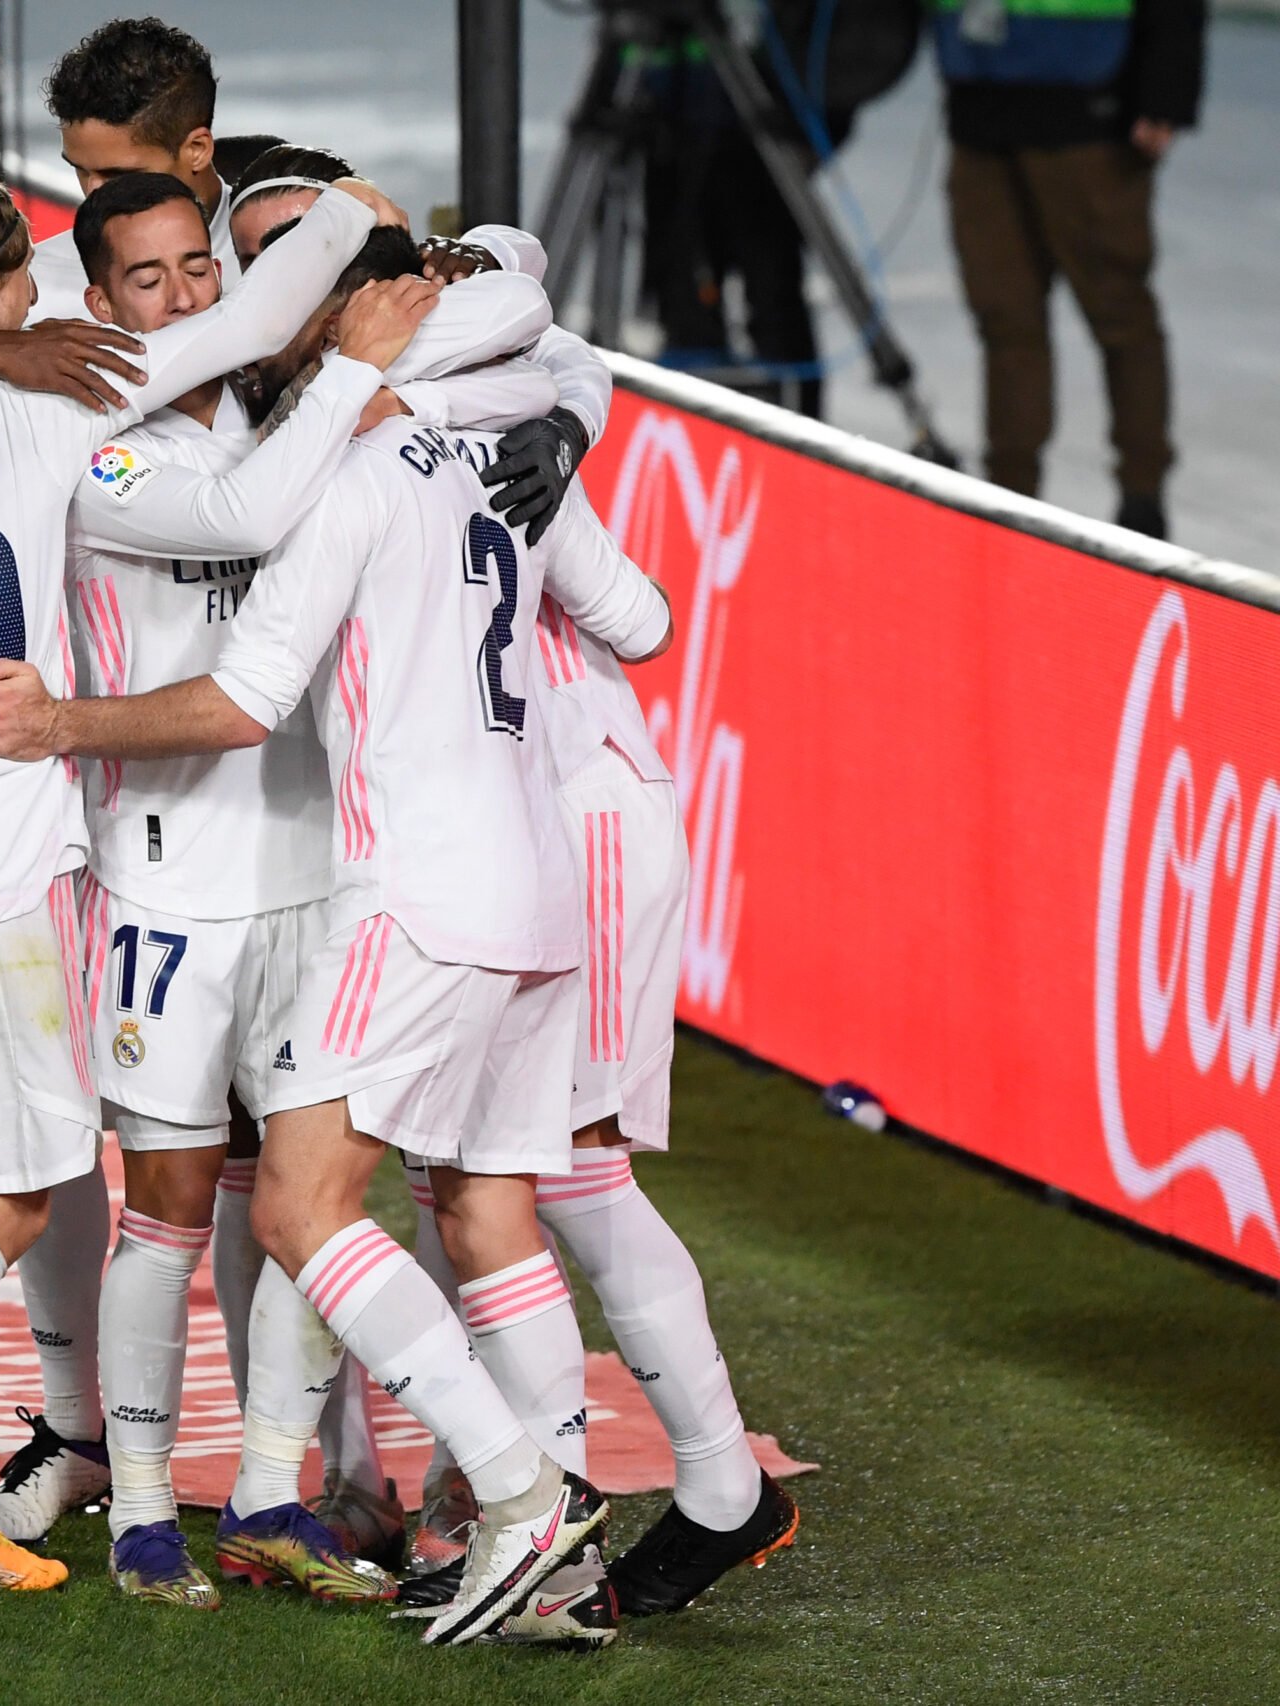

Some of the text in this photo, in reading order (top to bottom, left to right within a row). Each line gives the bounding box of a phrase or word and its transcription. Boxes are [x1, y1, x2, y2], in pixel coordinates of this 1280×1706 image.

[115, 467, 152, 497] LaLiga
[462, 512, 526, 741] 2
[111, 924, 188, 1019] 17
[34, 1334, 73, 1347] ADRID
[110, 1410, 170, 1424] MADRID
[118, 1405, 159, 1416] REAL
